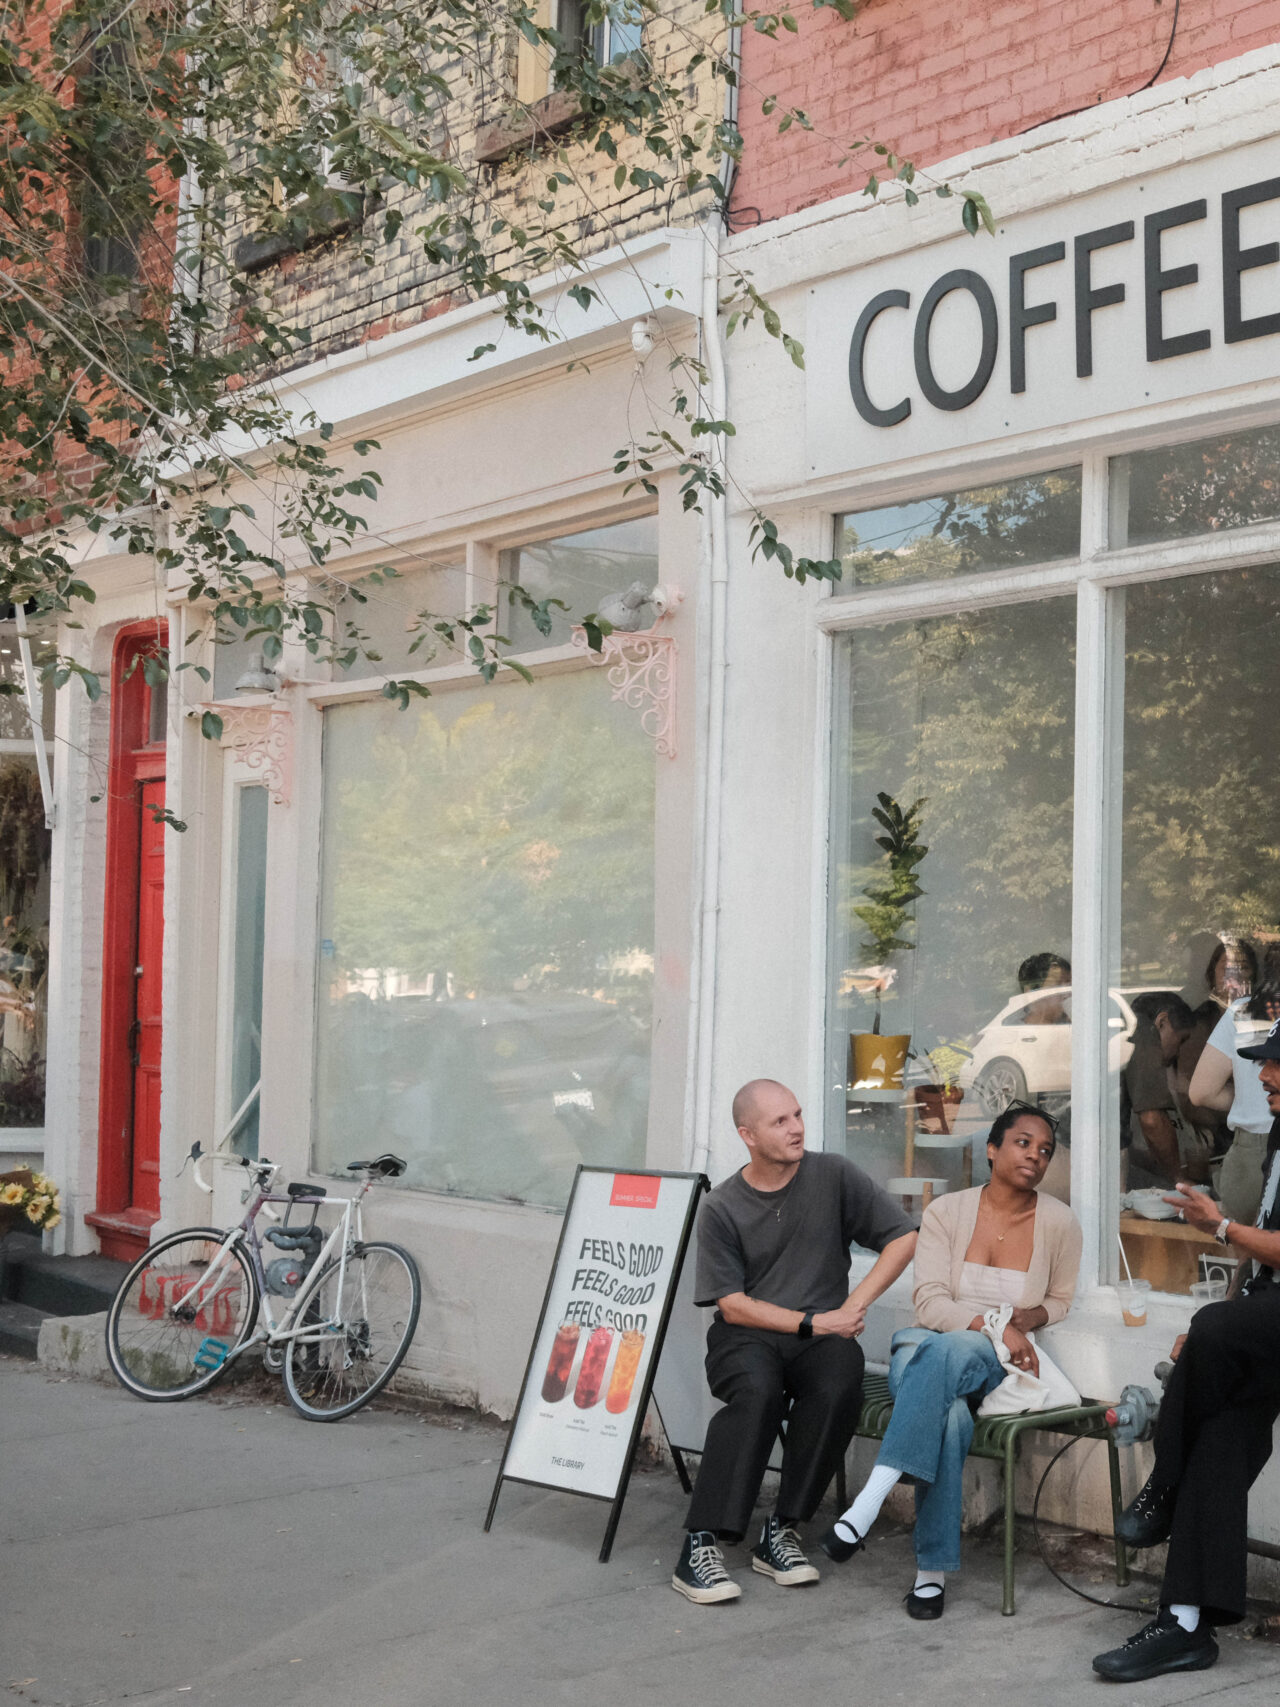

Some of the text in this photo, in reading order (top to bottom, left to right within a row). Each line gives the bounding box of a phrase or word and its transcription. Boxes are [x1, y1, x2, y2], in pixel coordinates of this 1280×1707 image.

[579, 1238, 664, 1278] FEELS GOOD
[571, 1268, 656, 1306] FEELS GOOD
[564, 1300, 603, 1328] FEELS
[551, 1456, 586, 1471] THE LIBRARY
